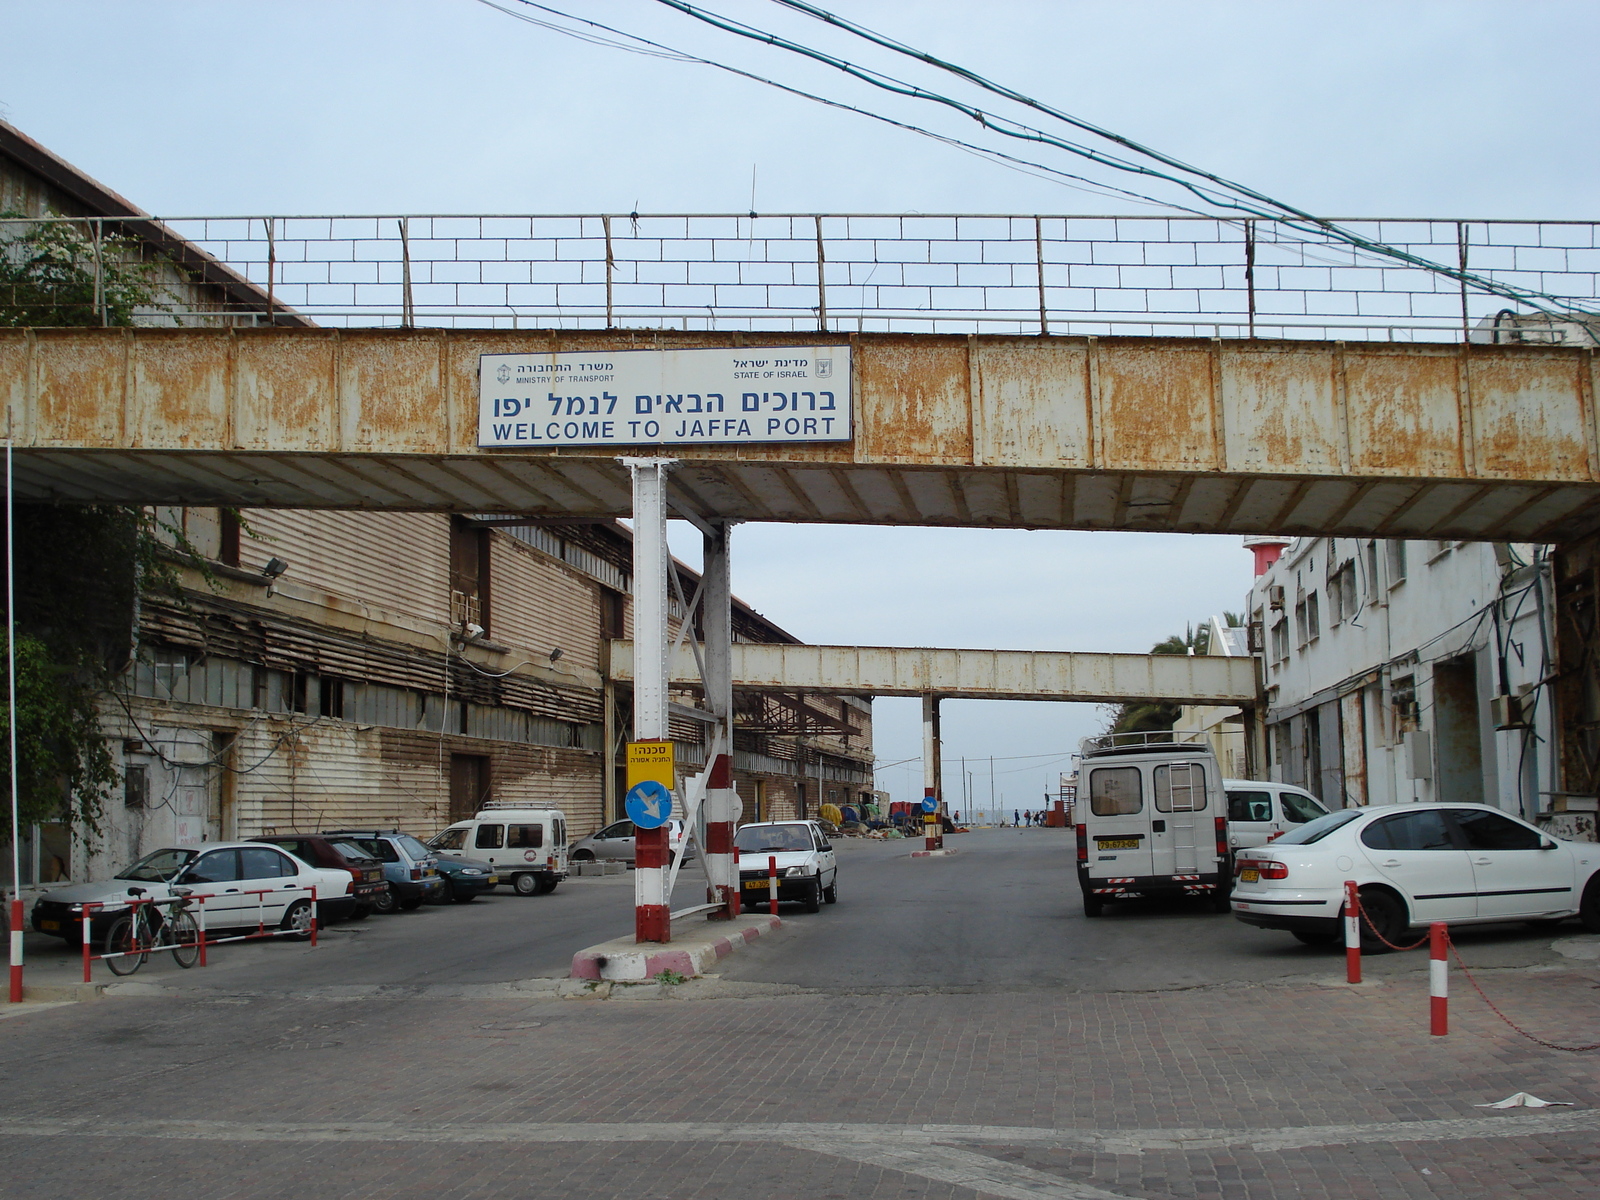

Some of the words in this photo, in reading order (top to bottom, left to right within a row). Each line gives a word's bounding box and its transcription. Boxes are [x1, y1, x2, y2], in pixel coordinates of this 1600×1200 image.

[579, 363, 614, 371] משרד
[733, 359, 769, 368] ישראל
[774, 359, 808, 367] מדינת
[517, 364, 572, 373] התחבורה
[516, 376, 551, 384] MINISTRY
[554, 375, 565, 383] OF
[569, 374, 615, 382] TRANSPORT
[733, 371, 759, 379] STATE
[777, 370, 808, 378] ISRAEL
[548, 392, 617, 416] לנמל
[635, 394, 724, 414] הבאים
[742, 392, 836, 411] ברוכים
[494, 397, 531, 417] יפו
[493, 421, 615, 440] WELCOME
[628, 420, 660, 438] TO
[675, 418, 752, 437] JAFFA
[767, 417, 836, 435] PORT
[634, 746, 666, 754] סכנה!
